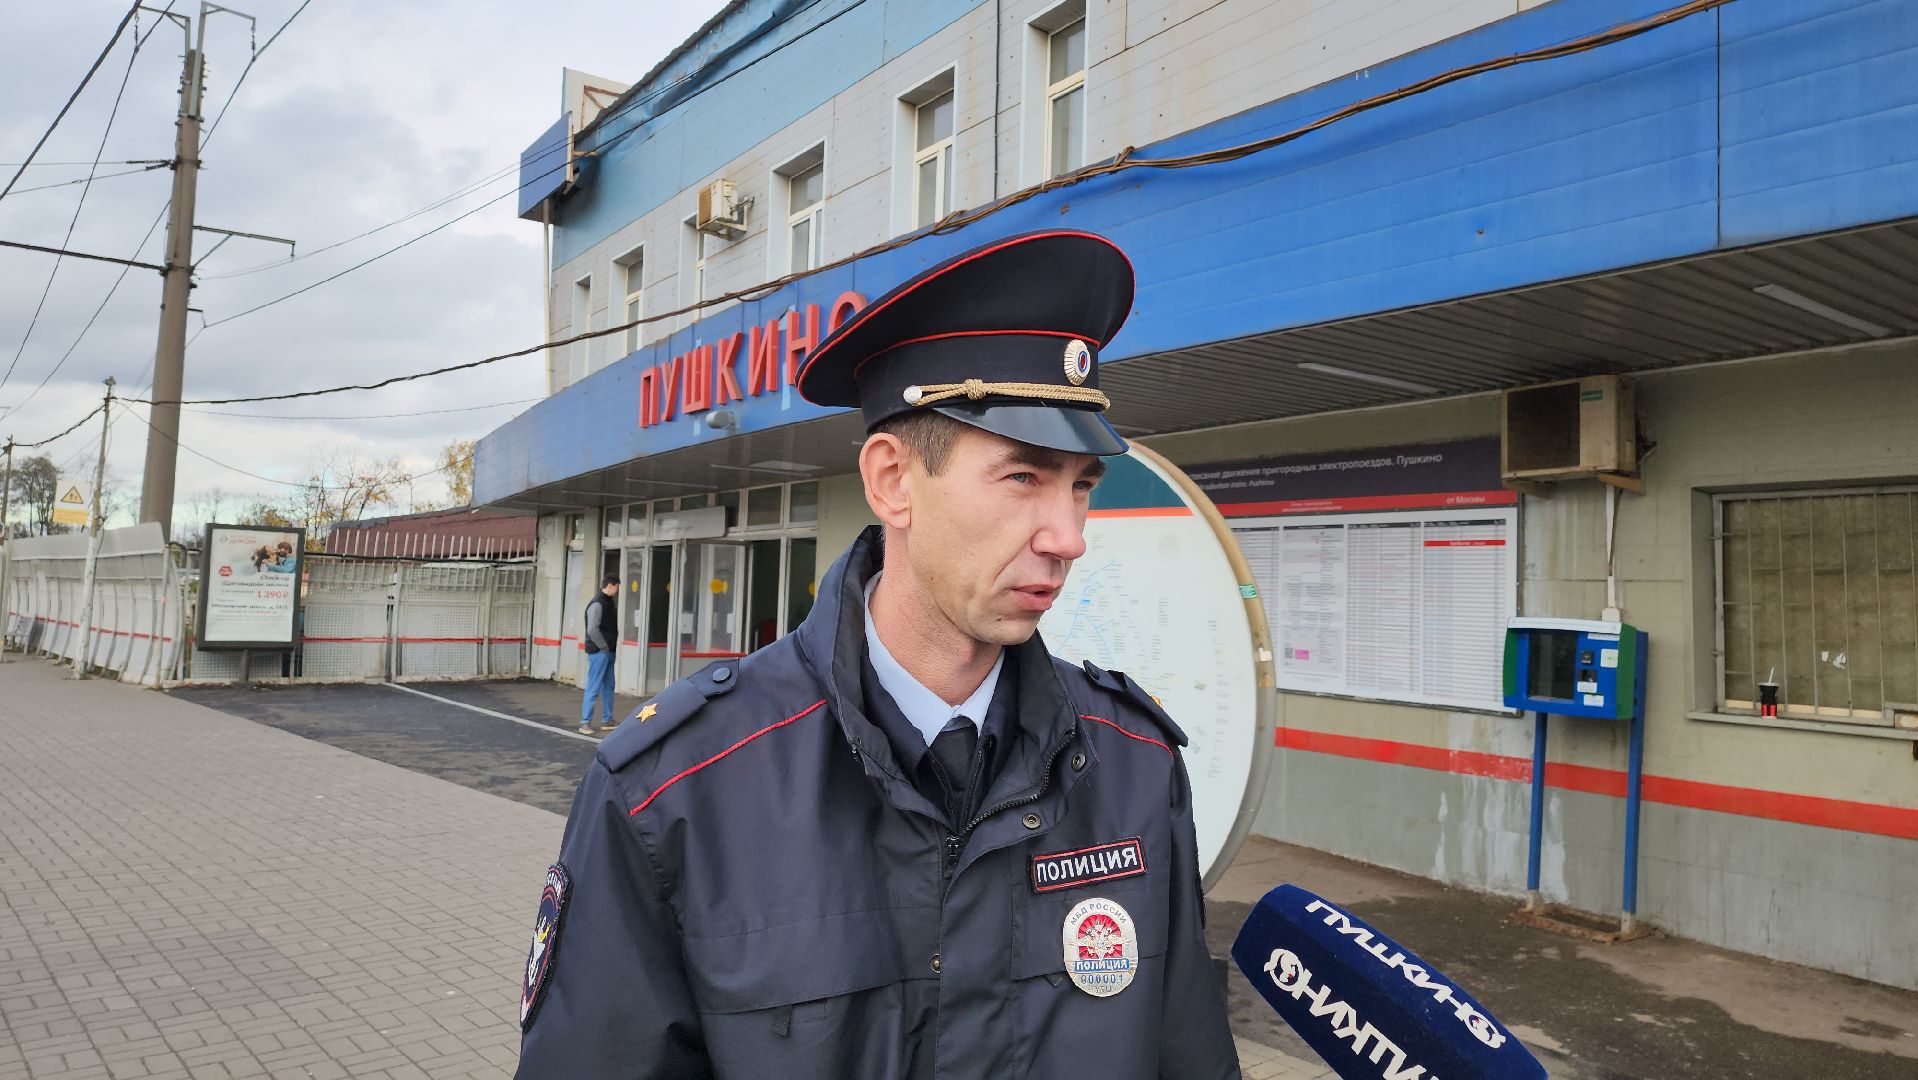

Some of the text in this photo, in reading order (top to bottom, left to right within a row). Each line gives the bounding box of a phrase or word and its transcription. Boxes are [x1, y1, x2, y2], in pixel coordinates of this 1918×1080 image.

[1222, 468, 1261, 479] движения
[1261, 464, 1317, 478] пригородных
[1318, 458, 1395, 472] электропоездов.
[1396, 452, 1443, 469] Пушкино
[1455, 495, 1486, 503] Москвы
[1036, 846, 1138, 883] ПОЛИЦИЯ
[1089, 902, 1127, 924] РОССИИ
[1076, 960, 1128, 971] ПОЛИЦИЯ
[1304, 899, 1506, 1049] ПУШКИНО
